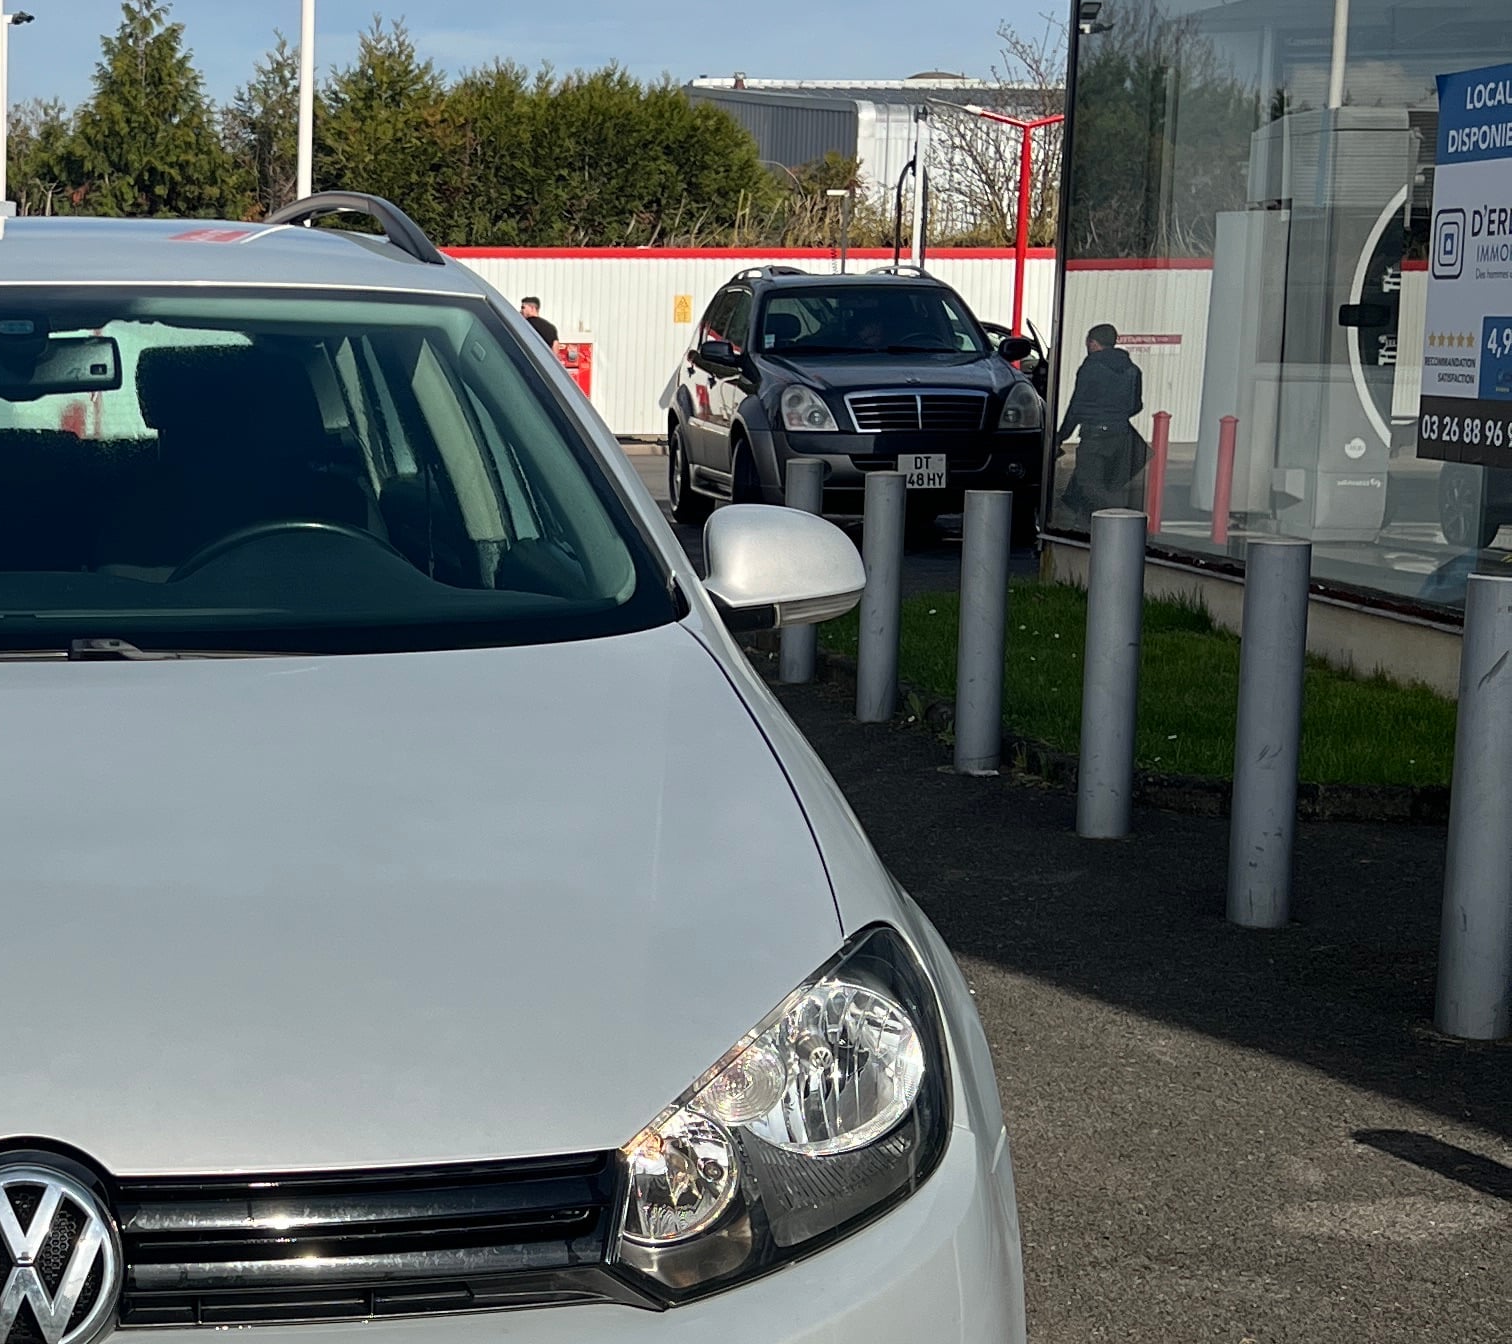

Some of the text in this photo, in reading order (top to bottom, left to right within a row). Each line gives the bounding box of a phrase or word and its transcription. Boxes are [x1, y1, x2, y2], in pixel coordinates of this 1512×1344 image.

[1471, 204, 1512, 237] D'ER
[1476, 244, 1512, 262] IMMO
[1424, 356, 1476, 368] RECOMMANDATION
[1437, 372, 1475, 384] SATISFACTION
[1421, 414, 1439, 440] 03
[1441, 416, 1460, 442] 26
[1463, 418, 1481, 444] 88
[1485, 419, 1503, 447] 96
[914, 456, 932, 470] DT
